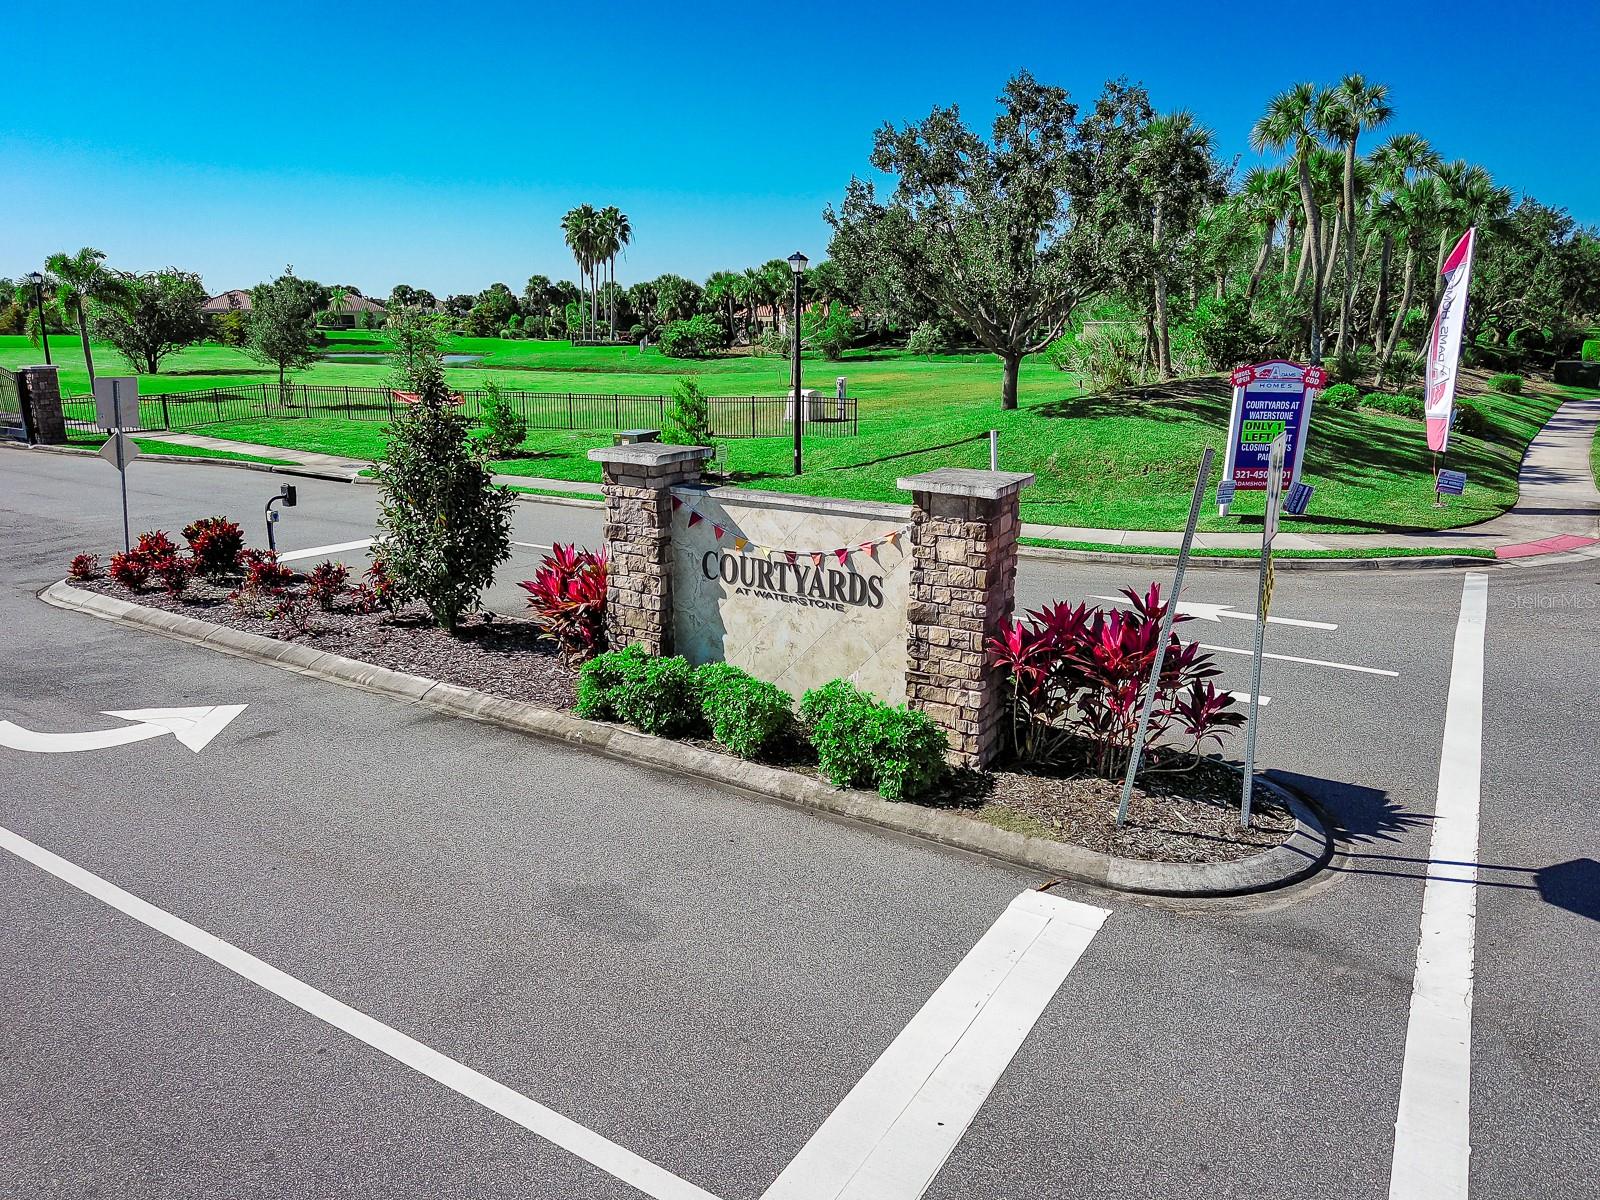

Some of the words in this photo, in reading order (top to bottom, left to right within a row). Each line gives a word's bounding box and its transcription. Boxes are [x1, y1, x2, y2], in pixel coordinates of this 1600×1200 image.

[1309, 370, 1320, 378] NO
[1305, 376, 1320, 385] CDD
[1245, 400, 1290, 410] COURTYARDS
[1290, 401, 1300, 410] AT
[1249, 411, 1294, 420] WATERSTONE
[1245, 421, 1273, 431] ONLY
[1276, 422, 1282, 431] 1
[1241, 443, 1270, 452] CLOSING
[1257, 453, 1270, 461] PAI
[1235, 470, 1291, 479] 321-45001
[702, 550, 884, 610] COURTYARDS
[735, 587, 751, 597] AT
[753, 590, 845, 612] WATERSTONE
